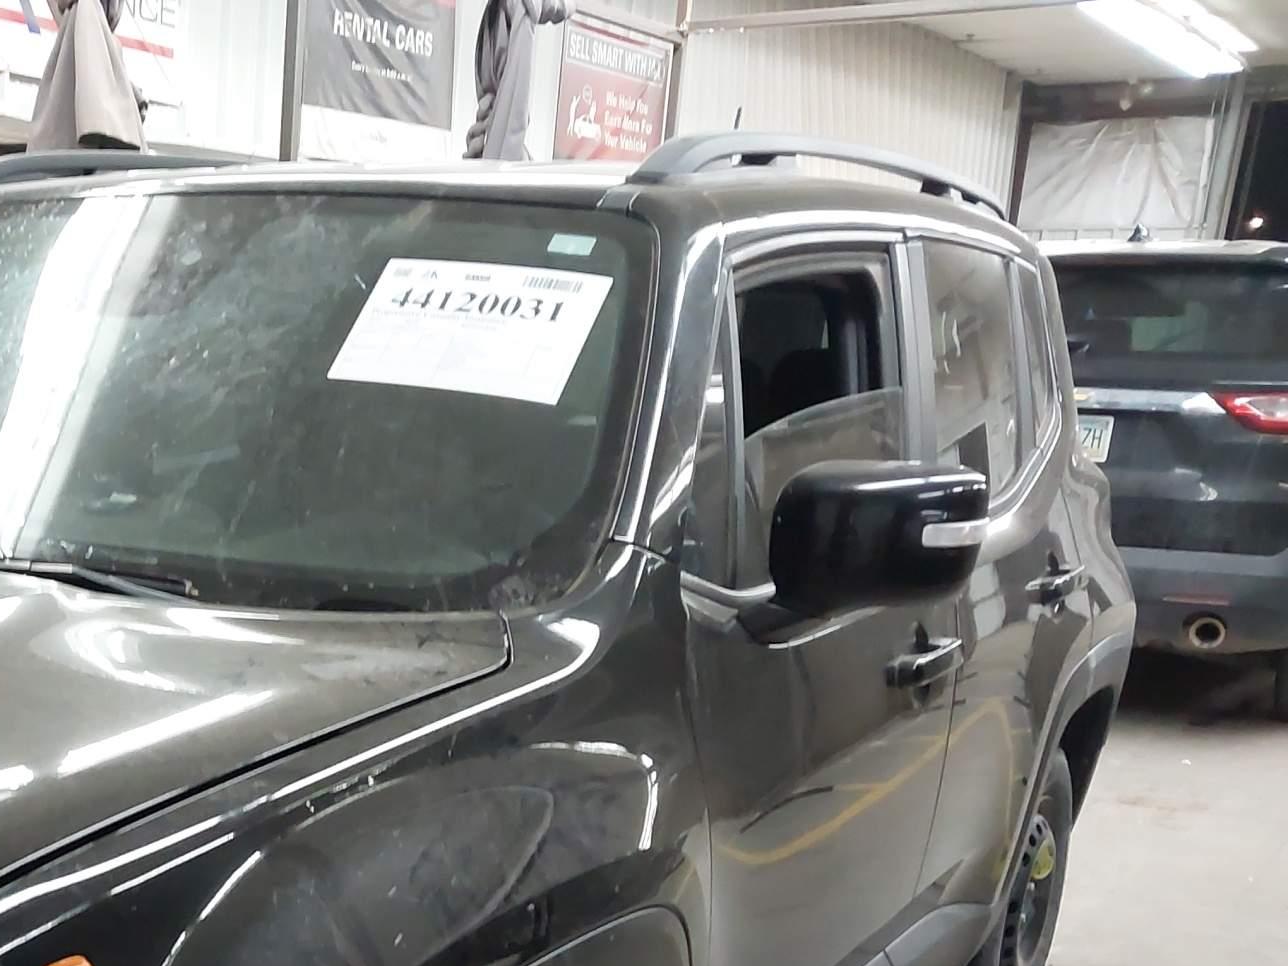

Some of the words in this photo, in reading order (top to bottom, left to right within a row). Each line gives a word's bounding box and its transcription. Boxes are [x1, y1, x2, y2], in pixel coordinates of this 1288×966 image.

[333, 8, 391, 48] RENTAL
[395, 24, 434, 57] CARS
[569, 33, 590, 61] SELL
[592, 40, 624, 69] SMART
[624, 51, 646, 79] WITH
[392, 287, 564, 323] 44120031
